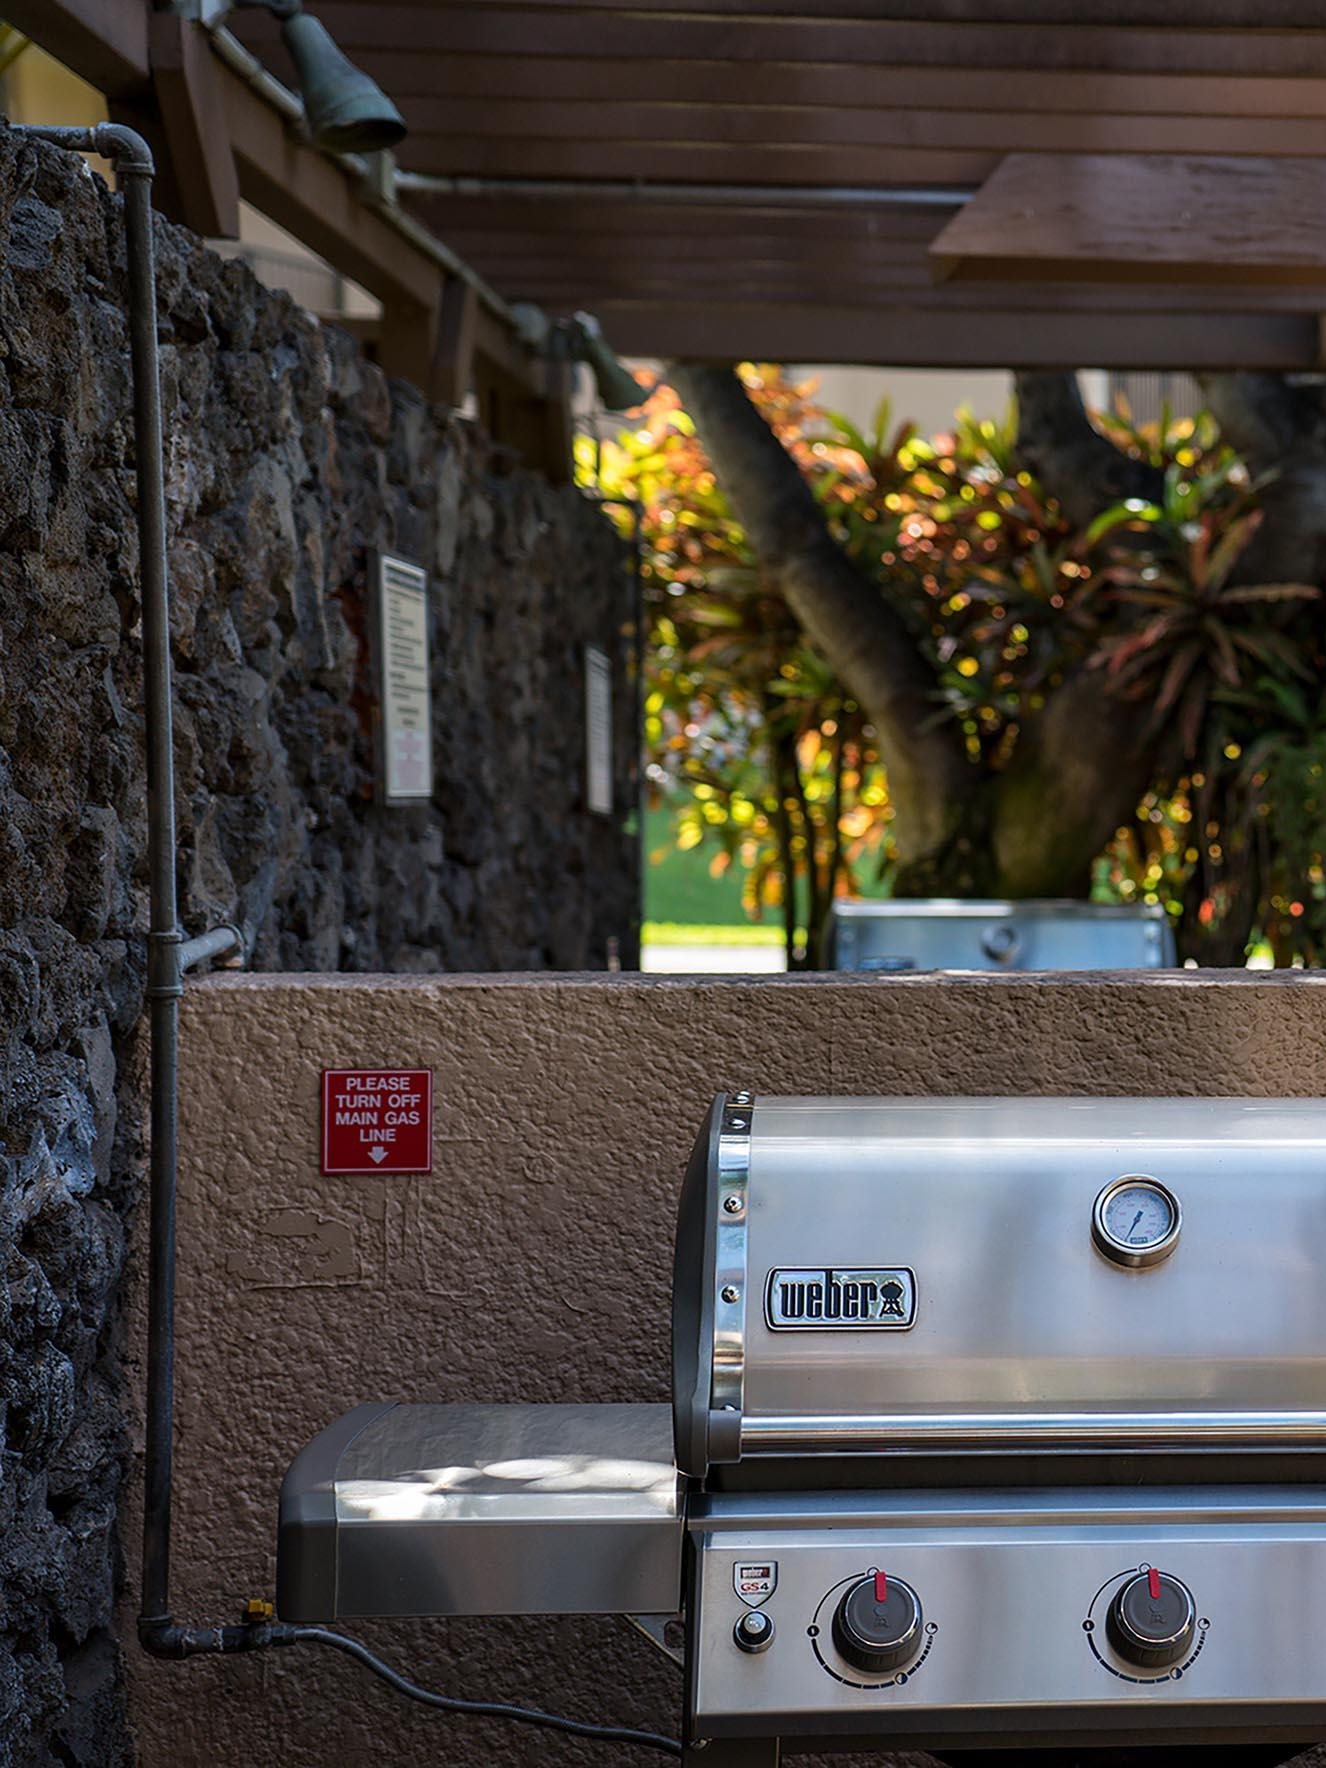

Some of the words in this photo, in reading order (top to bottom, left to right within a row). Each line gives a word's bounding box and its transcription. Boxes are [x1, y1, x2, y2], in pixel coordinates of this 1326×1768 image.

[346, 1077, 410, 1091] PLEASE
[335, 1094, 381, 1108] TURN
[388, 1094, 421, 1108] OFF
[335, 1112, 378, 1125] MAIN
[384, 1111, 420, 1125] GAS
[360, 1129, 396, 1142] LINE
[780, 1270, 878, 1318] weber
[741, 1582, 769, 1591] GS4
